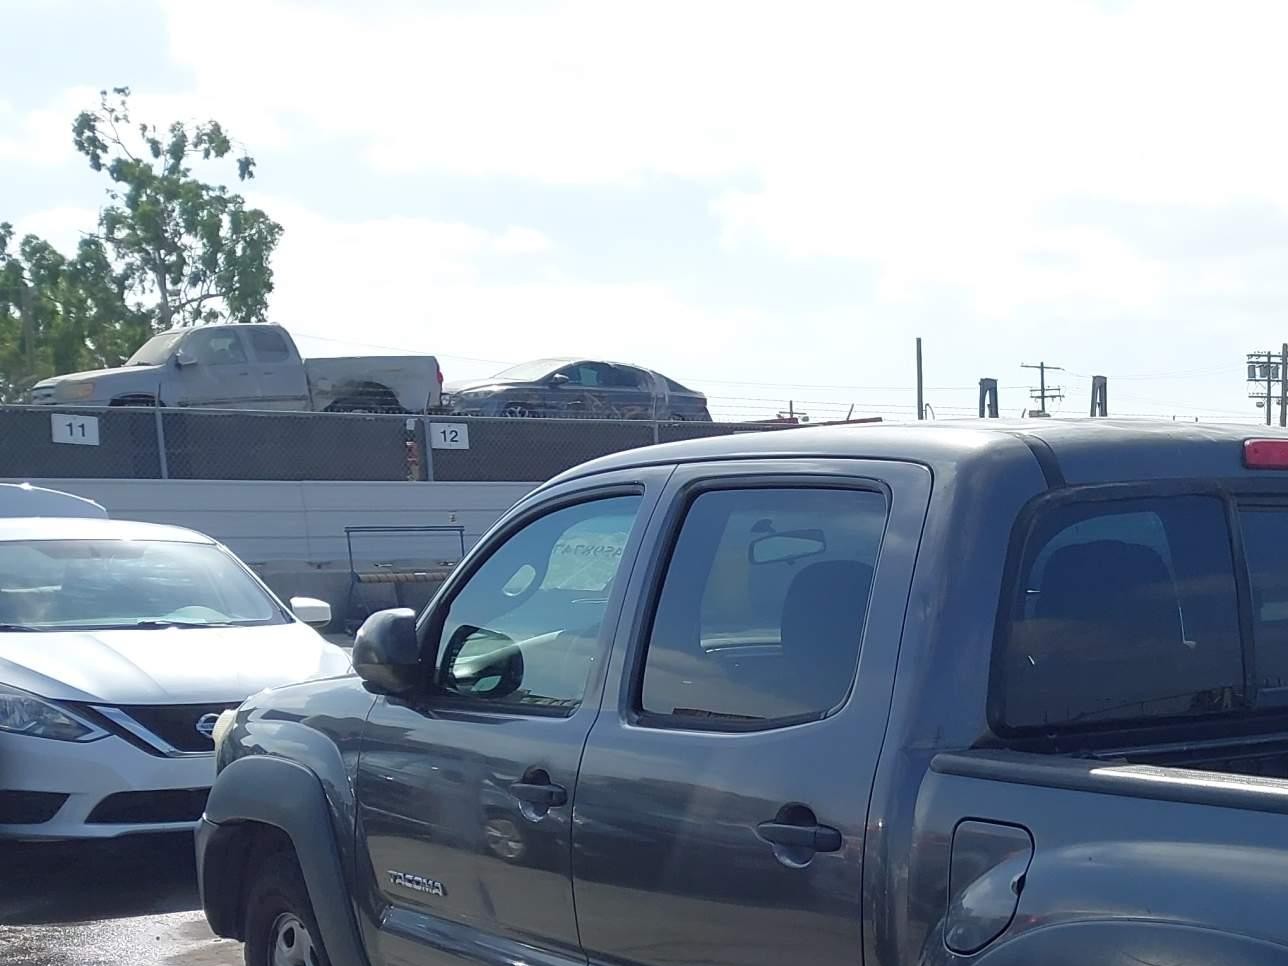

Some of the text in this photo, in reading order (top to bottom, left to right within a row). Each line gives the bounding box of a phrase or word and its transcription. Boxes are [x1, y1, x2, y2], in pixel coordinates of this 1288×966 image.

[65, 422, 86, 437] 11
[440, 429, 459, 443] 12
[386, 869, 443, 897] TACOMA
